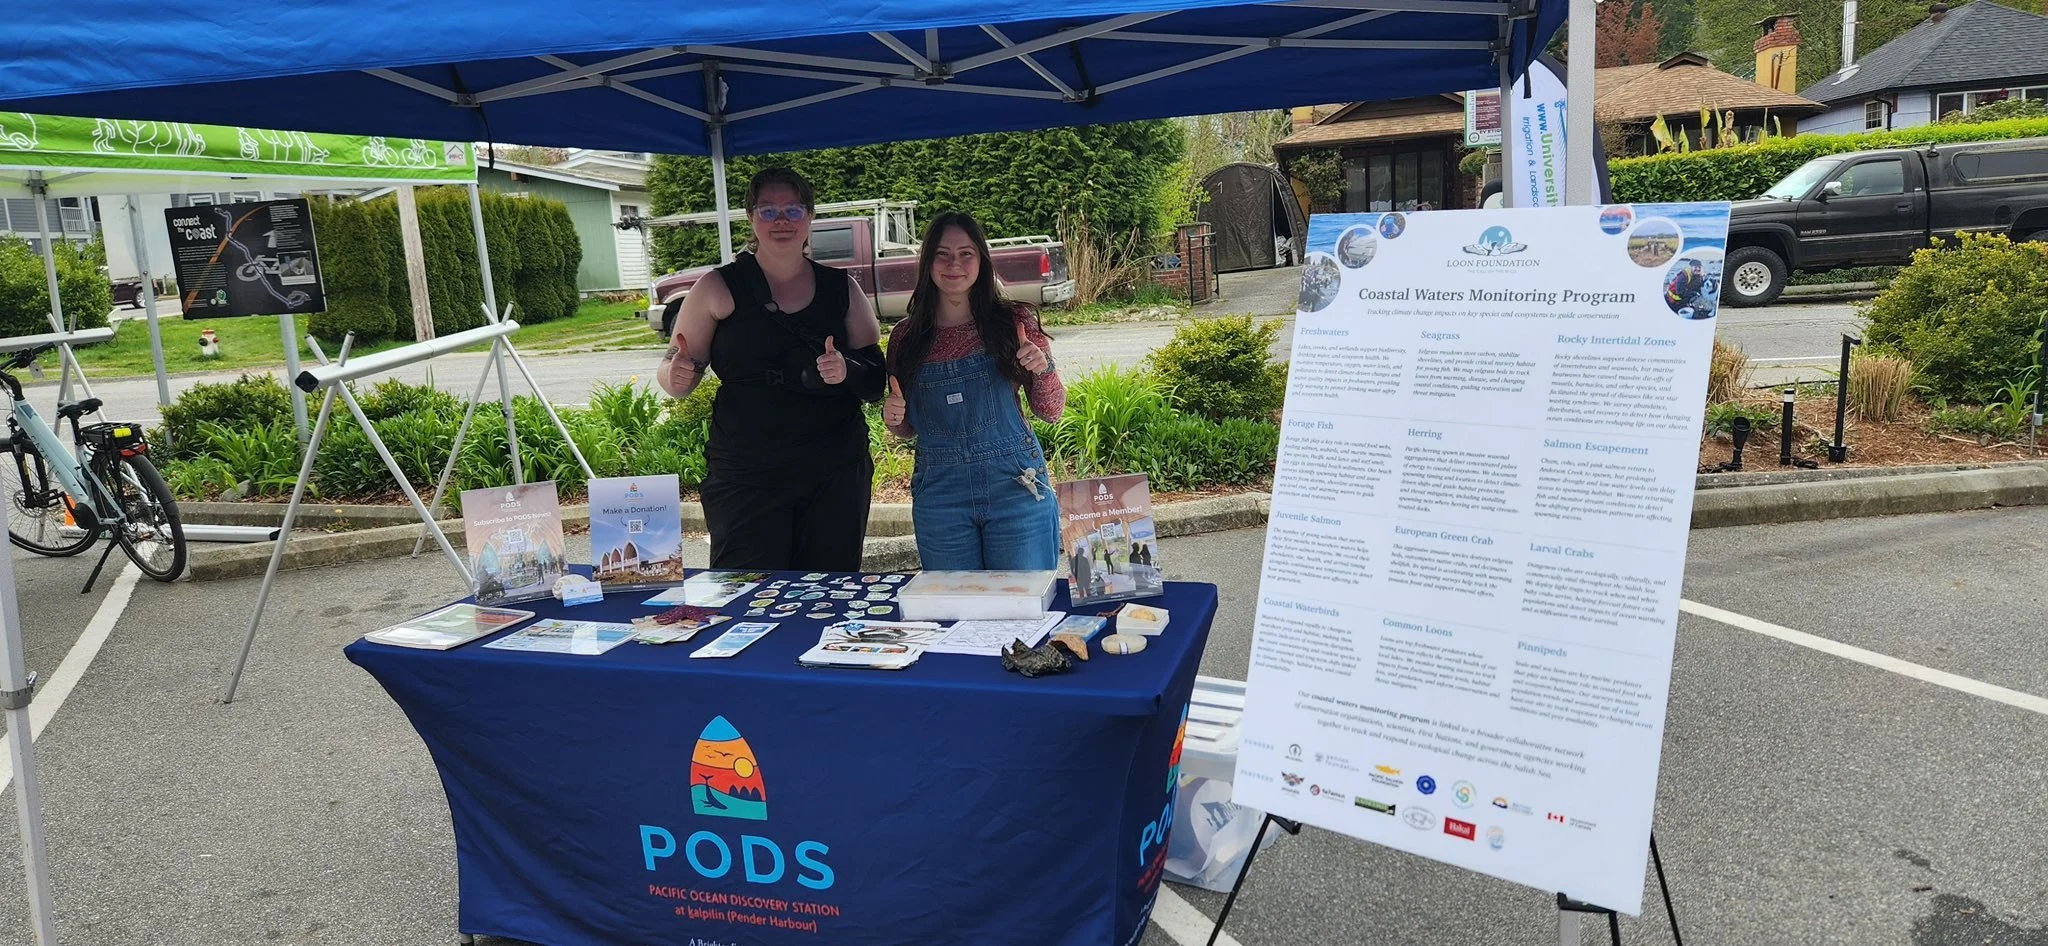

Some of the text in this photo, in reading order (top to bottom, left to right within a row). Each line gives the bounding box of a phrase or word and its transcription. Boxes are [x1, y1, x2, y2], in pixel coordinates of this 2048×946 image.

[1522, 116, 1534, 156] Irrigation
[1528, 159, 1536, 167] &
[1359, 288, 1636, 306] Coastal Waters Monitoring Program
[1300, 328, 1349, 336] Freshwaters
[1421, 331, 1460, 340] Seagrass
[1557, 335, 1676, 346] Rocky Intertidal Zones
[1288, 419, 1334, 429] Forage Fish
[1408, 428, 1442, 440] Herring
[1544, 439, 1649, 455] Salmon Escapement
[631, 505, 666, 513] Donation!
[1069, 511, 1101, 520] Become
[1109, 506, 1142, 516] Member!
[474, 518, 505, 526] Subscribe
[1275, 510, 1342, 526] Juvenile Salmon
[1395, 525, 1493, 545] European Green Crab
[1530, 542, 1594, 558] Larval Crabs
[1264, 597, 1339, 617] Coastal Waterbirds
[1383, 618, 1453, 637] Common Loons
[1517, 640, 1568, 657] Pinnipeds
[1312, 694, 1335, 703] coastal
[1336, 699, 1358, 708] waters
[1360, 704, 1398, 719] monitoring
[1399, 713, 1430, 724] program
[1439, 721, 1461, 731] linked
[1477, 729, 1504, 740] broader
[1554, 747, 1584, 758] network
[1369, 730, 1382, 738] and
[1452, 748, 1475, 760] change
[1501, 760, 1511, 768] the
[1514, 764, 1536, 774] Salish
[1465, 740, 1479, 748] and
[1555, 761, 1586, 774] working
[639, 825, 835, 890] PODS
[648, 884, 840, 916] PACIFIC OCEAN DISCOVERY STATION
[675, 907, 685, 915] at
[727, 911, 766, 925] (Pender
[770, 916, 817, 933] Harbour)
